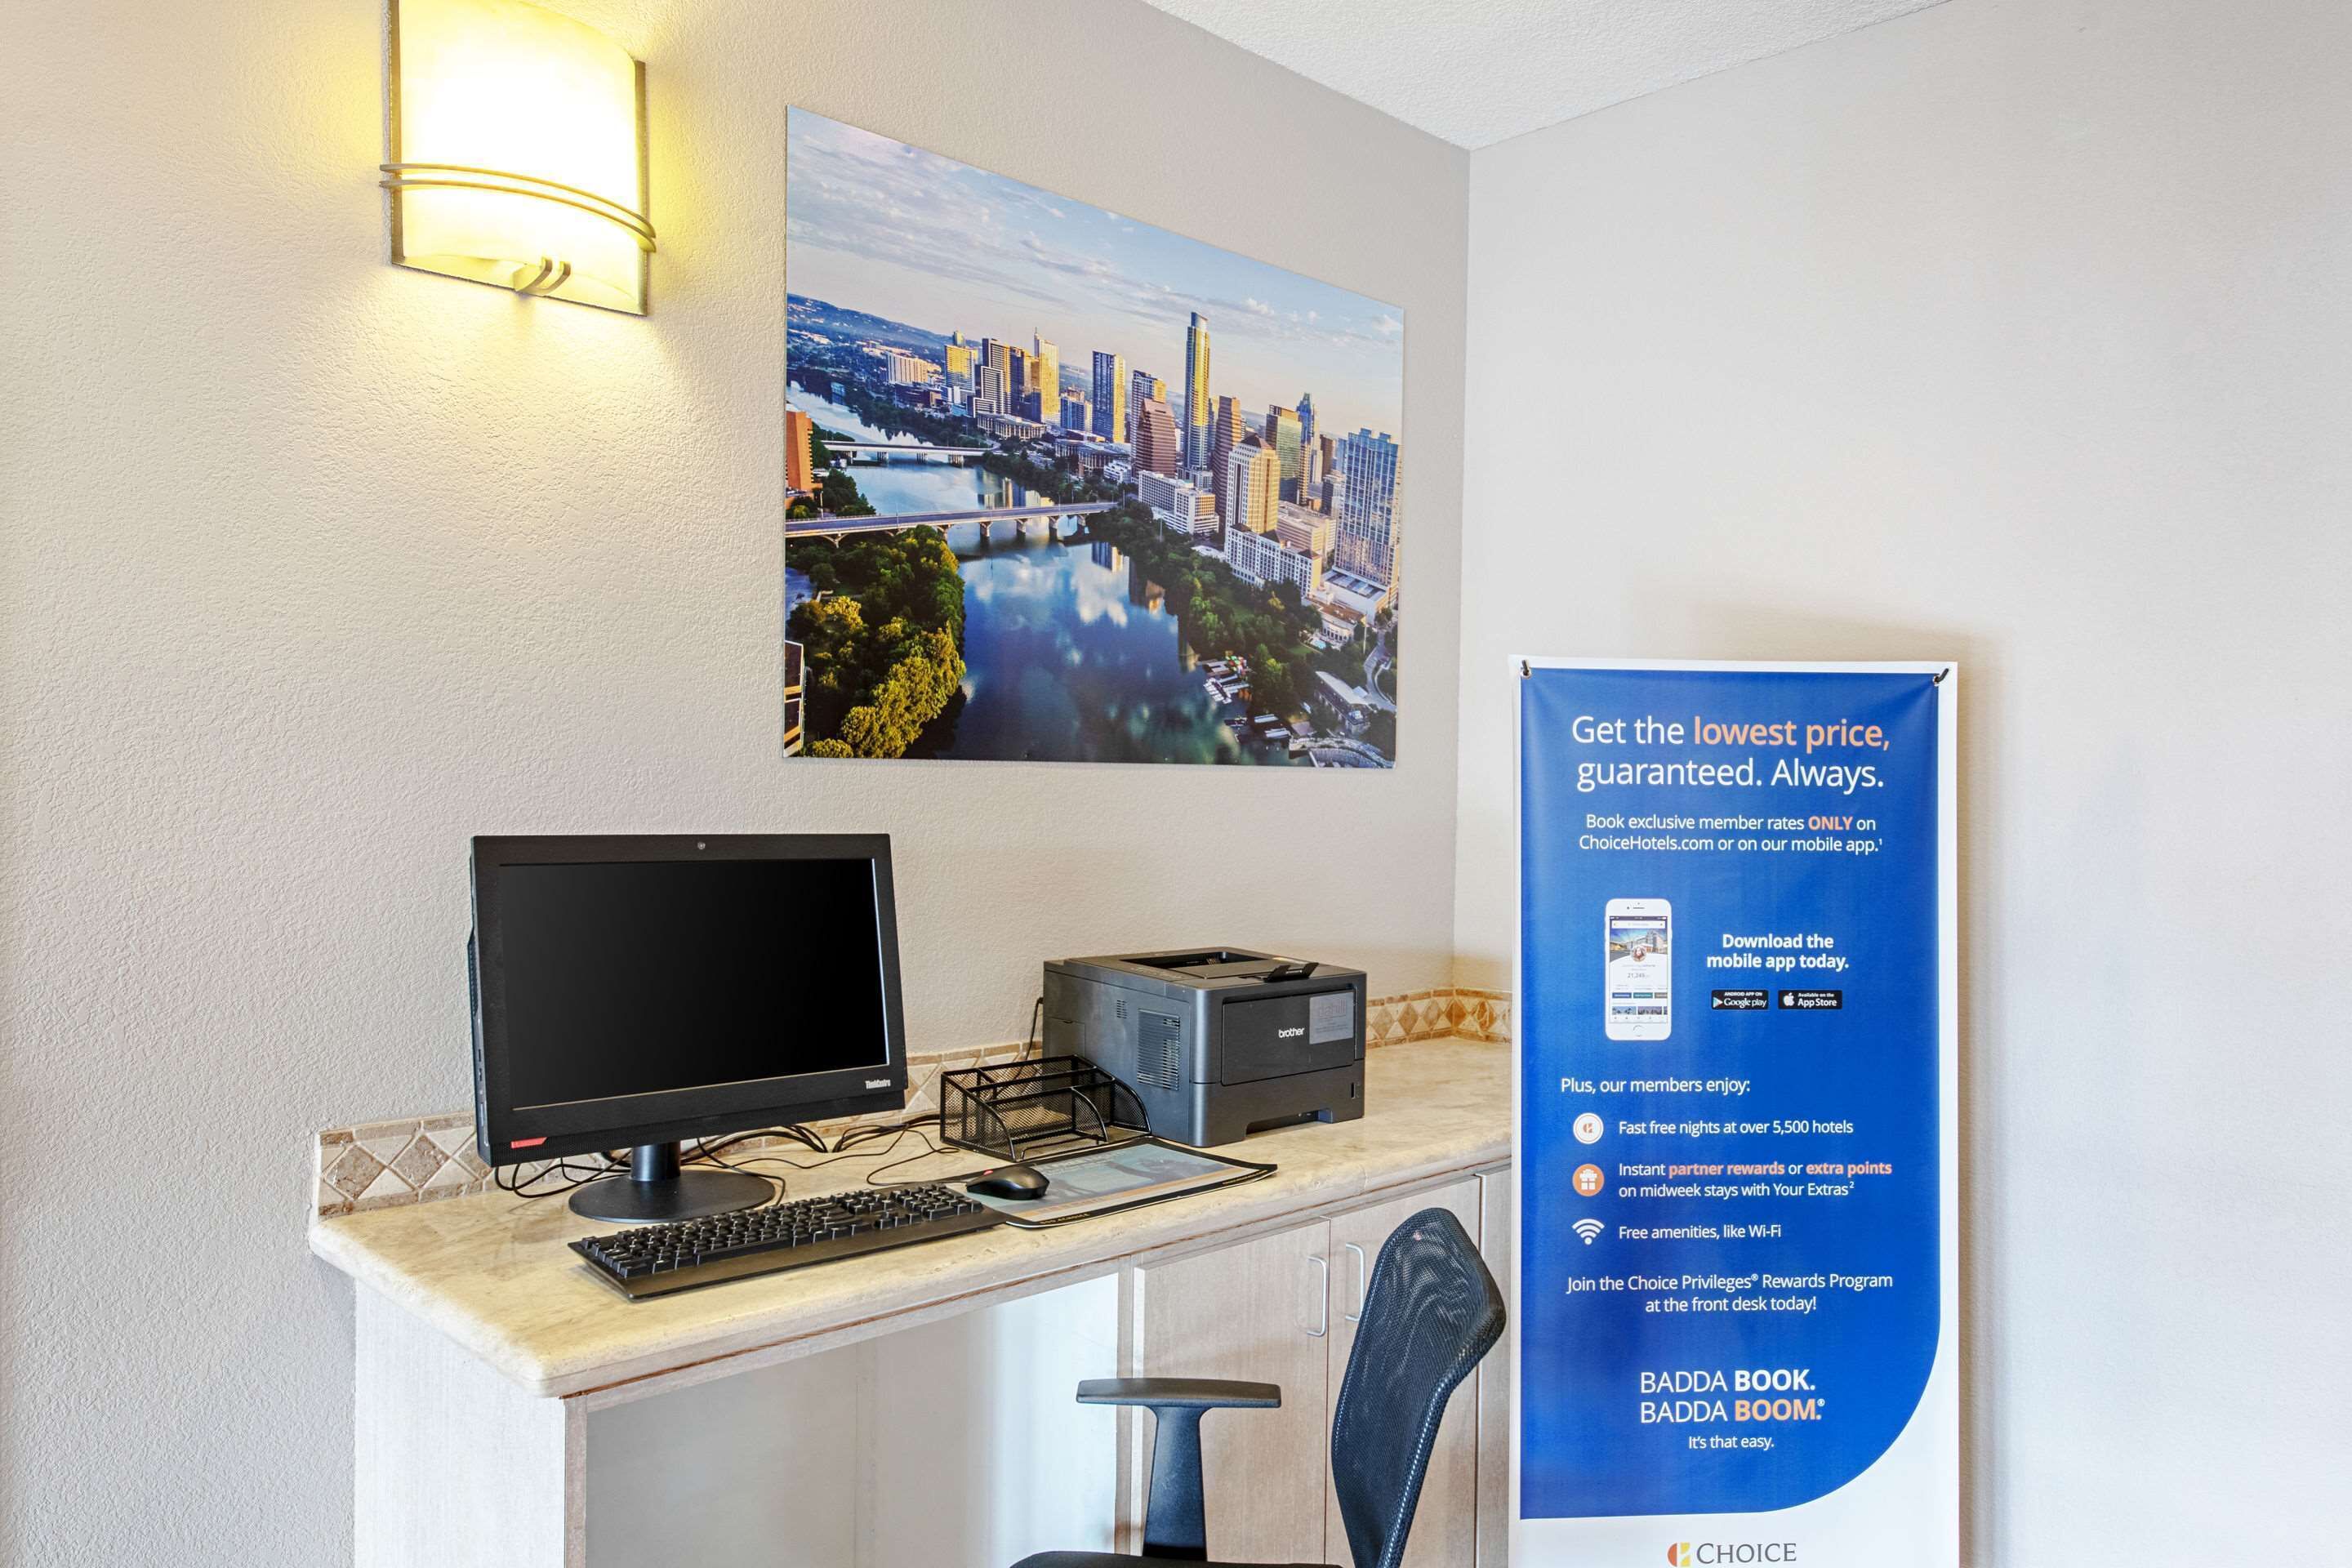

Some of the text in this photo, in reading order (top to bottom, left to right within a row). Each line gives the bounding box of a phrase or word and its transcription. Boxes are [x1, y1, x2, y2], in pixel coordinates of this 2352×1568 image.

[1572, 715, 1889, 754] Get the lowest price,
[1577, 758, 1883, 795] guaranteed. Always.
[1587, 814, 1875, 830] Book exclusive member rates ONLY on
[1579, 835, 1713, 849] ChoiceHotels.com
[1718, 840, 1734, 850] or
[1738, 840, 1757, 850] on
[1762, 840, 1788, 850] our
[1792, 837, 1842, 851] mobile
[1723, 933, 1833, 948] Download the
[1707, 953, 1849, 972] mobile app today.
[1724, 998, 1766, 1009] Google play
[1797, 998, 1837, 1008] App Store
[1278, 1027, 1304, 1038] brother
[1561, 1077, 1750, 1095] Plus, our members enjoy:
[1619, 1120, 1853, 1137] Fast free nights at over 5,500 hotels
[1619, 1161, 1892, 1178] Instant partner rewards or extra points
[1619, 1187, 1636, 1197] on
[1641, 1183, 1701, 1196] midweek
[1704, 1185, 1738, 1200] stays
[1741, 1183, 1770, 1196] with
[1773, 1183, 1804, 1196] Your
[1619, 1225, 1780, 1240] Free amenities, like Wi-Fi
[1566, 1277, 1595, 1294] Join
[1599, 1276, 1624, 1290] the
[1628, 1276, 1677, 1290] Choice
[1763, 1273, 1825, 1288] Rewards
[1830, 1274, 1892, 1291] Program
[1646, 1296, 1816, 1313] at the front desk today!
[1642, 1370, 1815, 1393] BADDA BOOK.
[1642, 1401, 1727, 1423] BADDA
[1689, 1435, 1774, 1450] It's that easy.
[1696, 1543, 1797, 1564] CHOICE
